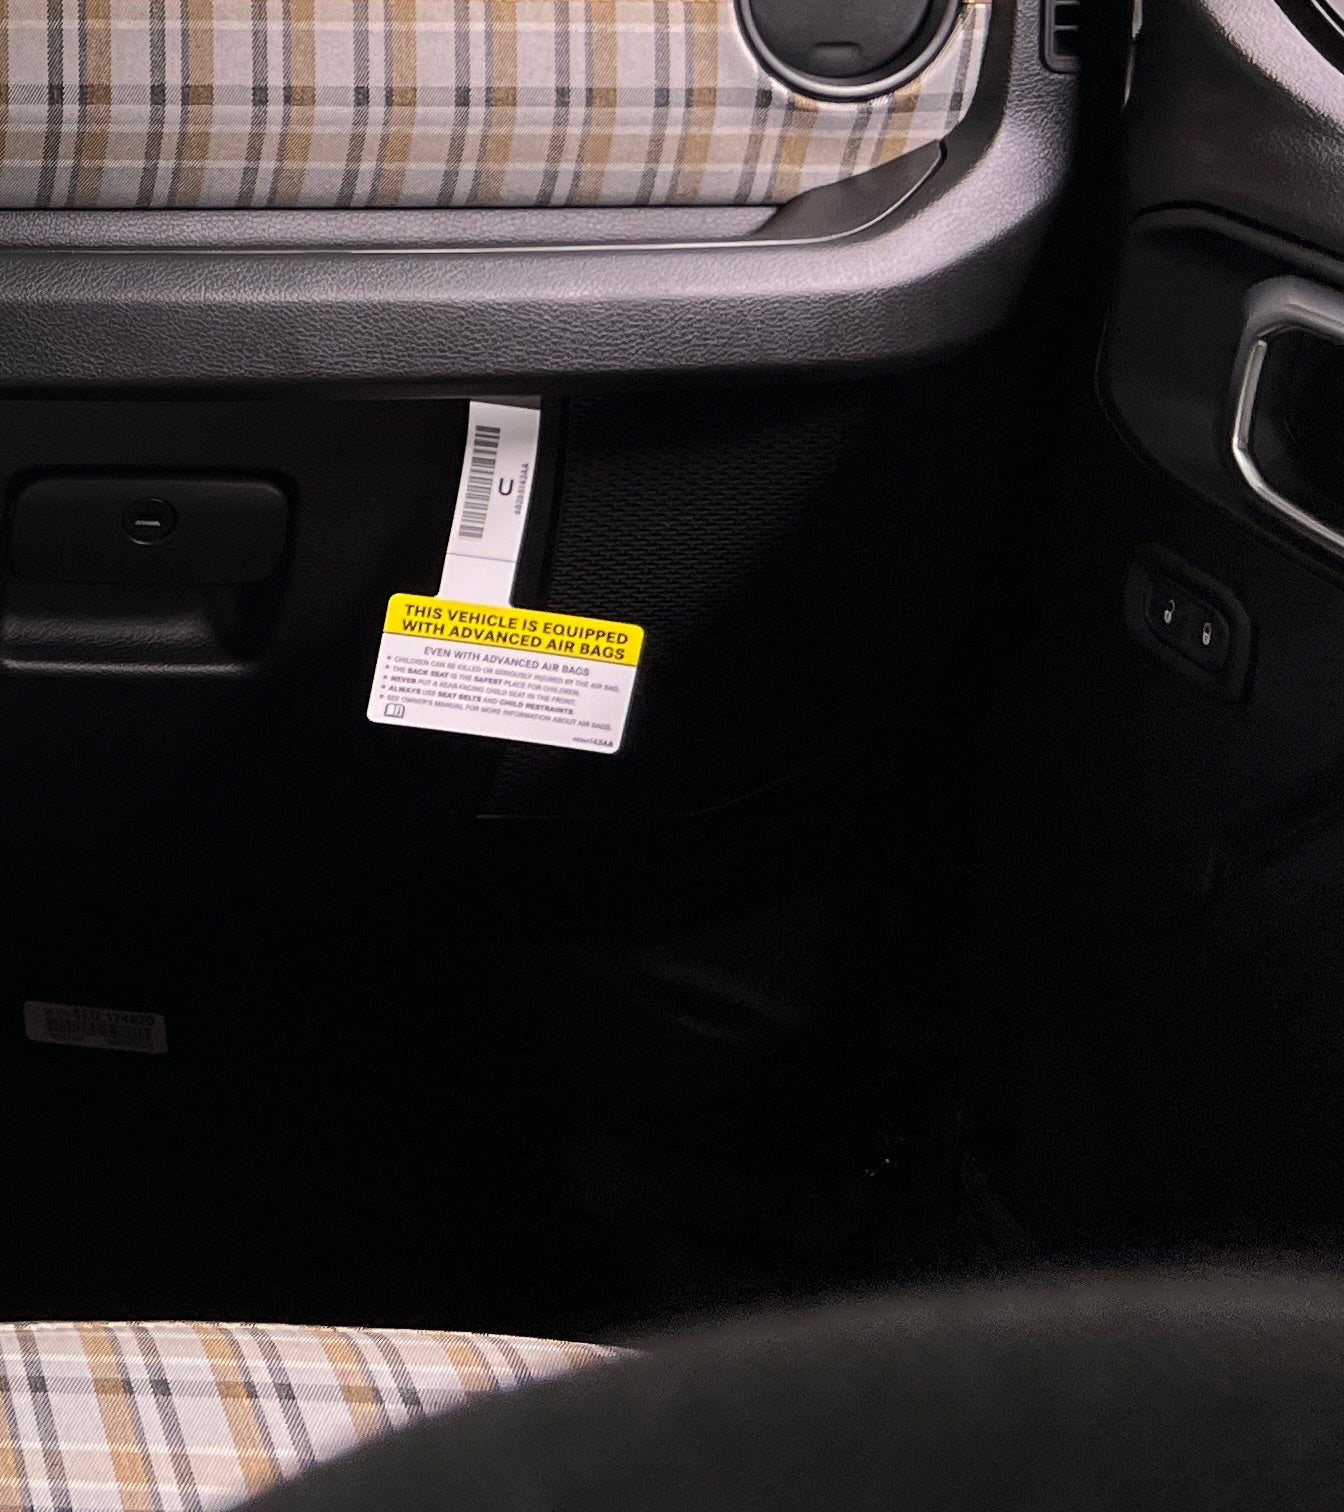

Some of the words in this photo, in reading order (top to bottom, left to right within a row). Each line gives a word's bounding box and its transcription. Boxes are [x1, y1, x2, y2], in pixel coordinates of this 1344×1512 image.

[402, 619, 445, 635] WITH
[448, 625, 542, 648] ADVANCED
[546, 638, 575, 653] AIR
[580, 644, 626, 660] BAGS
[405, 604, 442, 620] THIS
[448, 609, 518, 630] VEHICLE
[522, 619, 537, 632] IS
[543, 622, 628, 645] EQUIPPED
[424, 646, 451, 658] EVEN
[454, 650, 480, 661] WITH
[482, 654, 540, 669] ADVANCED
[541, 662, 560, 673] AIR
[562, 665, 590, 676] BAGS
